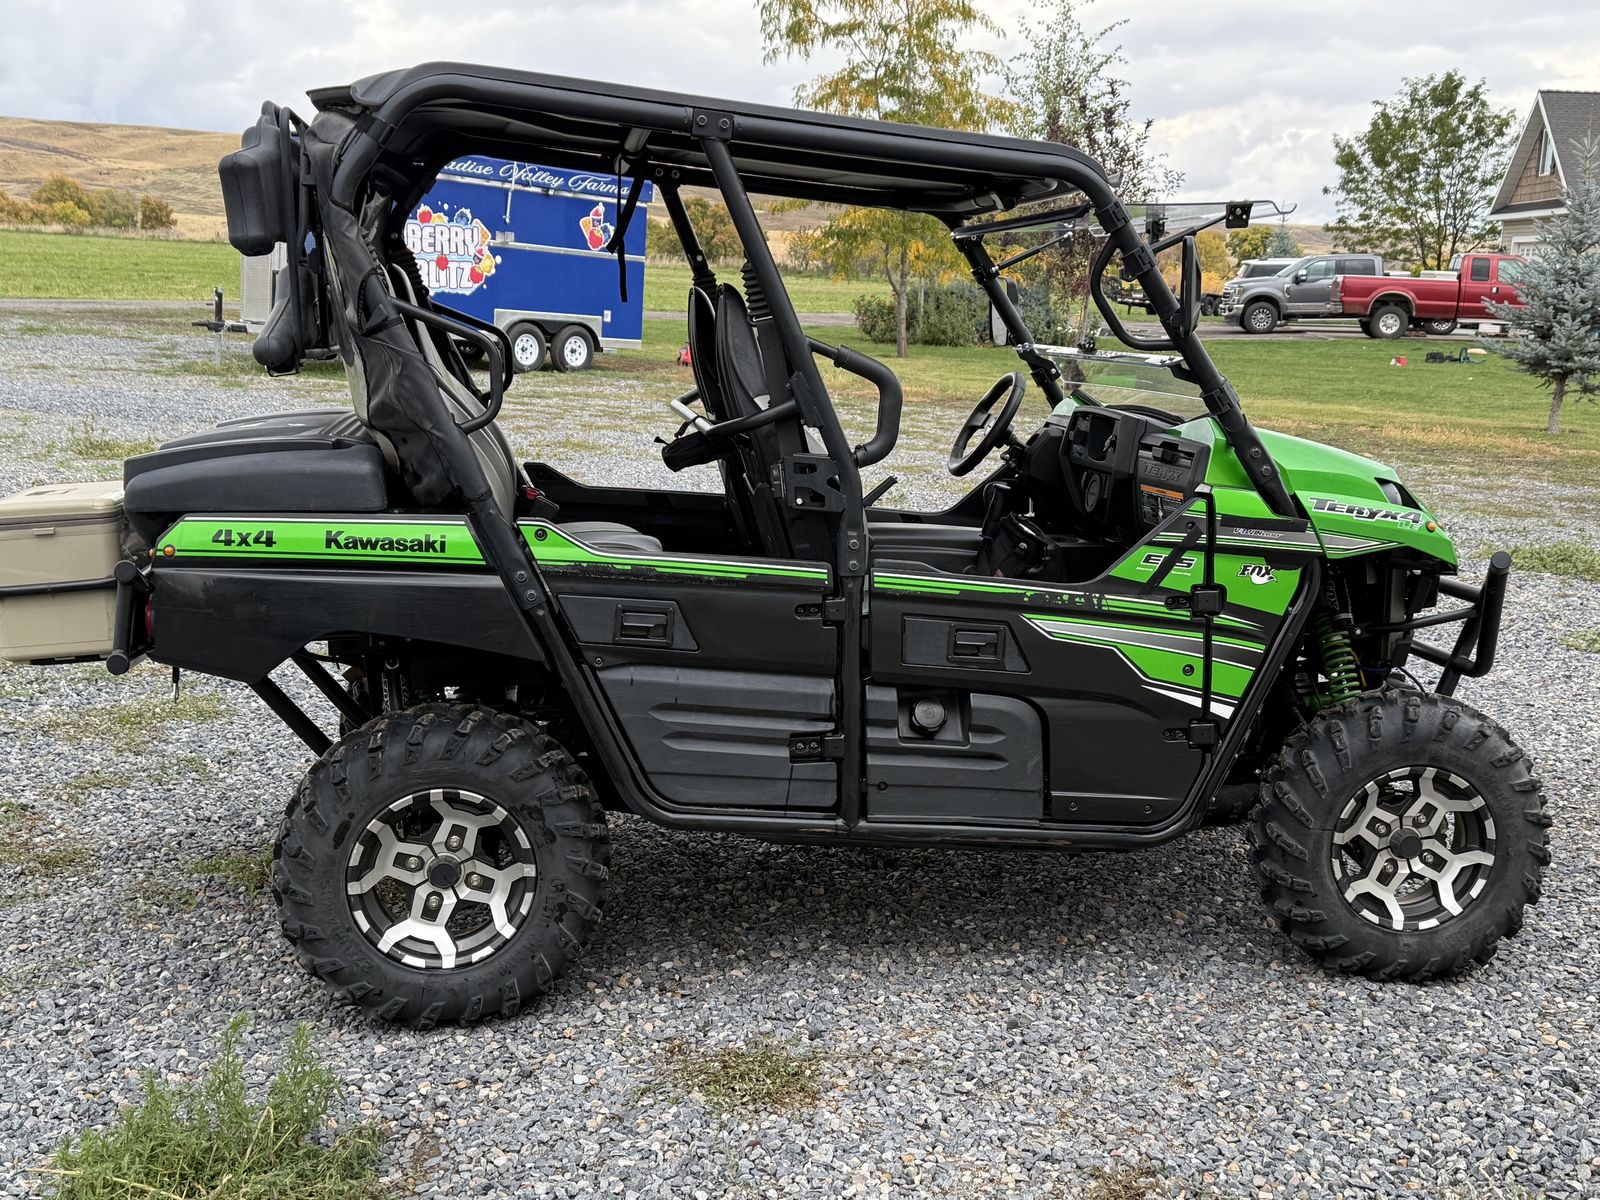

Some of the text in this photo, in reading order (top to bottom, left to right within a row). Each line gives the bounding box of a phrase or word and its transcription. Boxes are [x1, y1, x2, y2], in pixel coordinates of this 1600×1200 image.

[444, 160, 631, 195] adise Valley Farms
[406, 223, 479, 257] BERRY
[211, 528, 277, 548] 4x4
[325, 530, 447, 554] Kawasaki
[1141, 553, 1197, 569] ES
[1238, 563, 1275, 579] FOX
